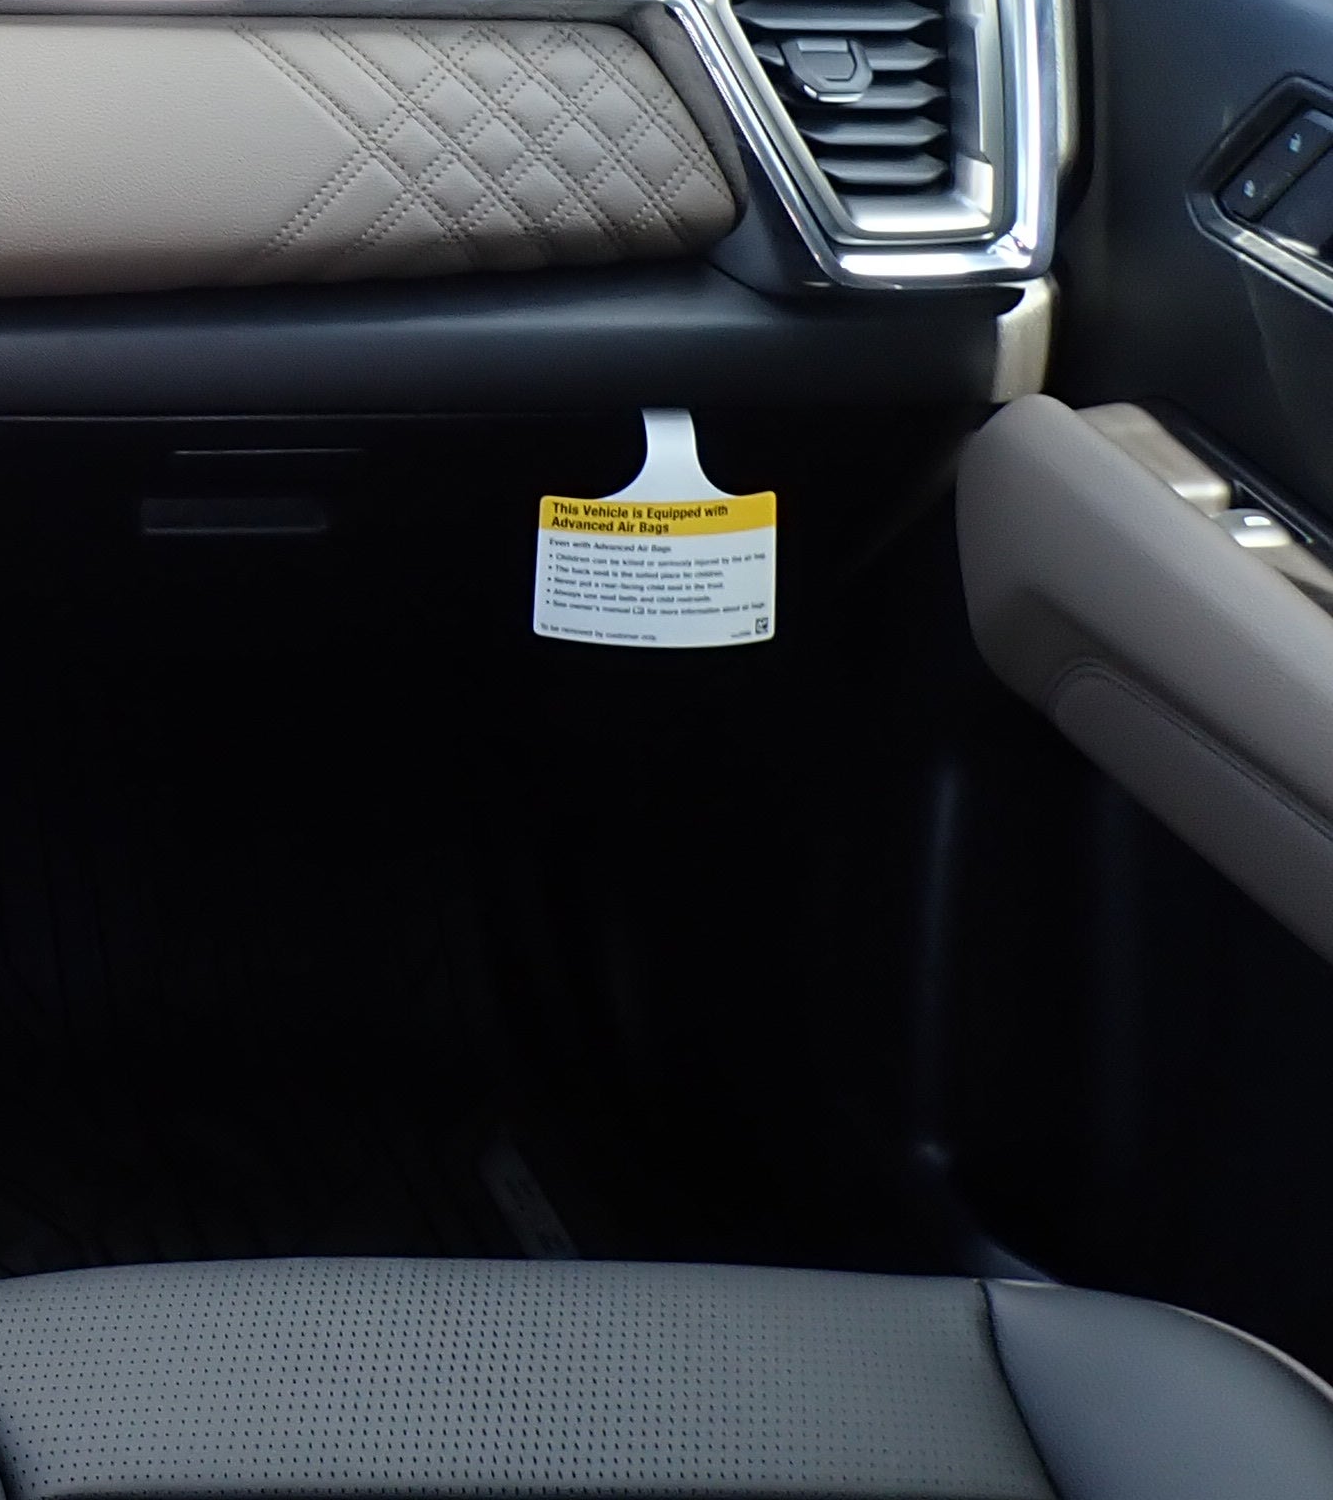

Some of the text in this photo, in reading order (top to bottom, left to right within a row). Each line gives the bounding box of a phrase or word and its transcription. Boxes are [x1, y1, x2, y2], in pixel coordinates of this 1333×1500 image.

[553, 502, 729, 522] This Vehicle is Equipped with
[551, 516, 669, 534] Advanced Air Bags
